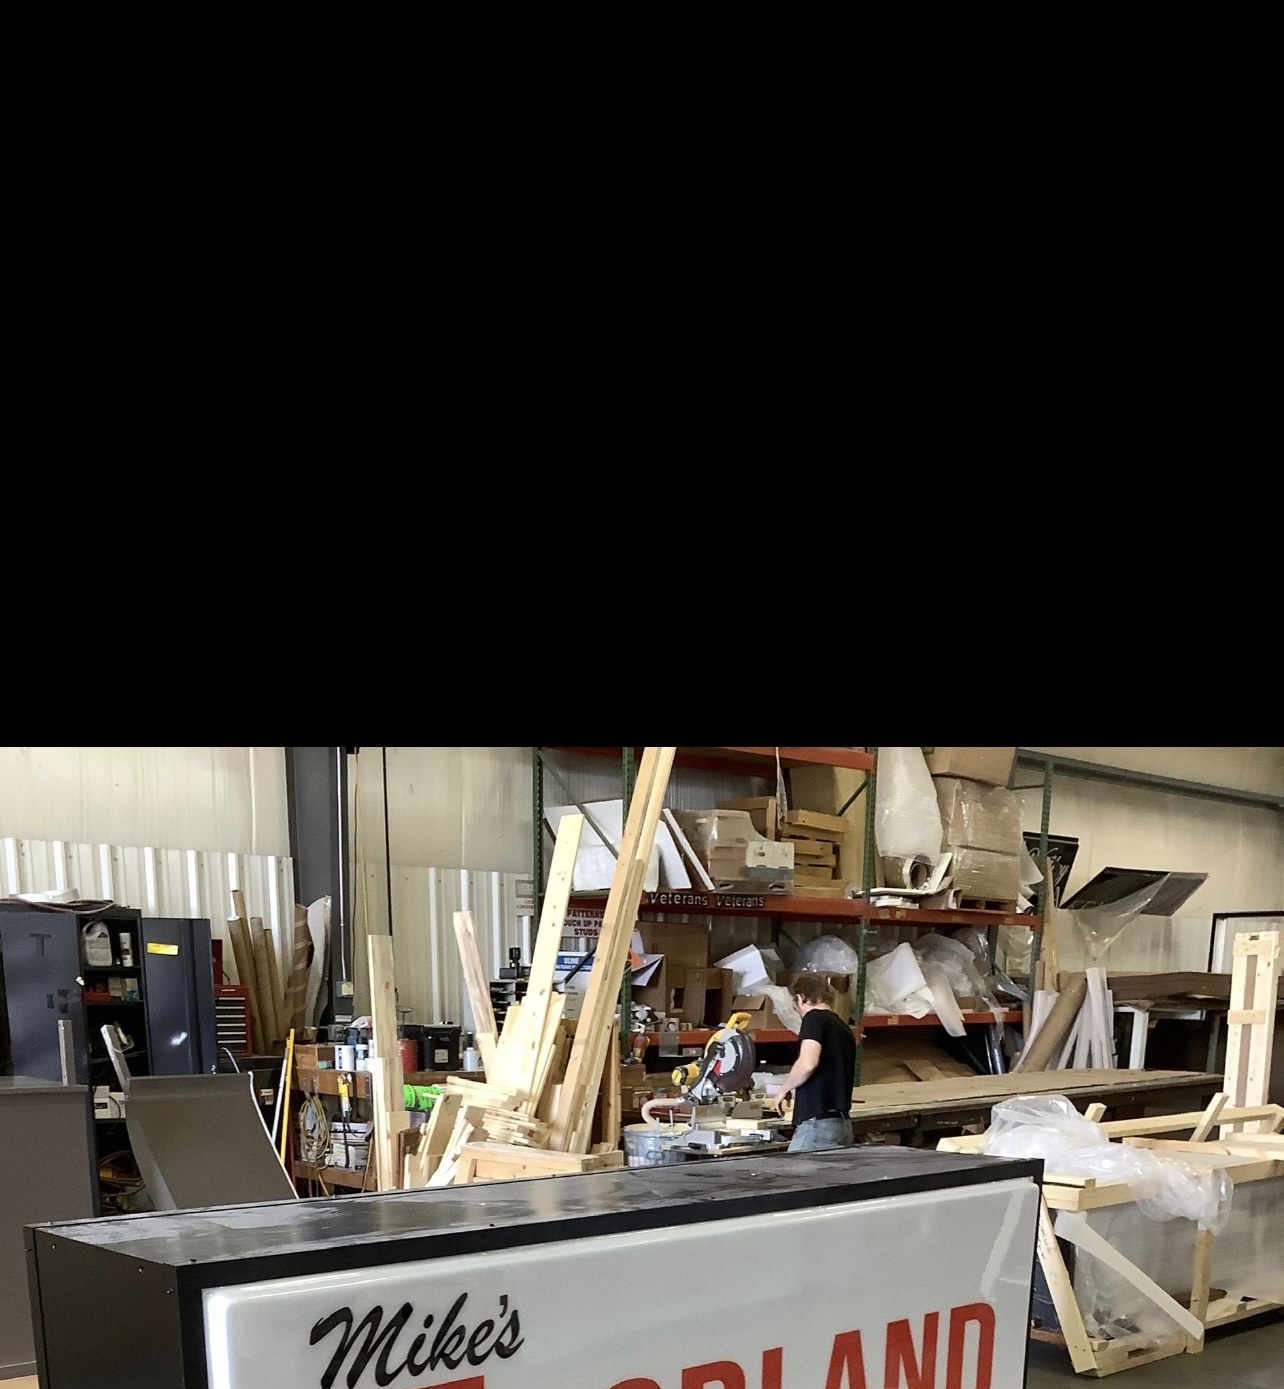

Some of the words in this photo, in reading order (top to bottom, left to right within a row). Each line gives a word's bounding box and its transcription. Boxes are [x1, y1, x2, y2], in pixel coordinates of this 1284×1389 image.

[650, 891, 708, 906] Veterans
[716, 894, 764, 907] Veterans
[574, 928, 598, 936] STUDS
